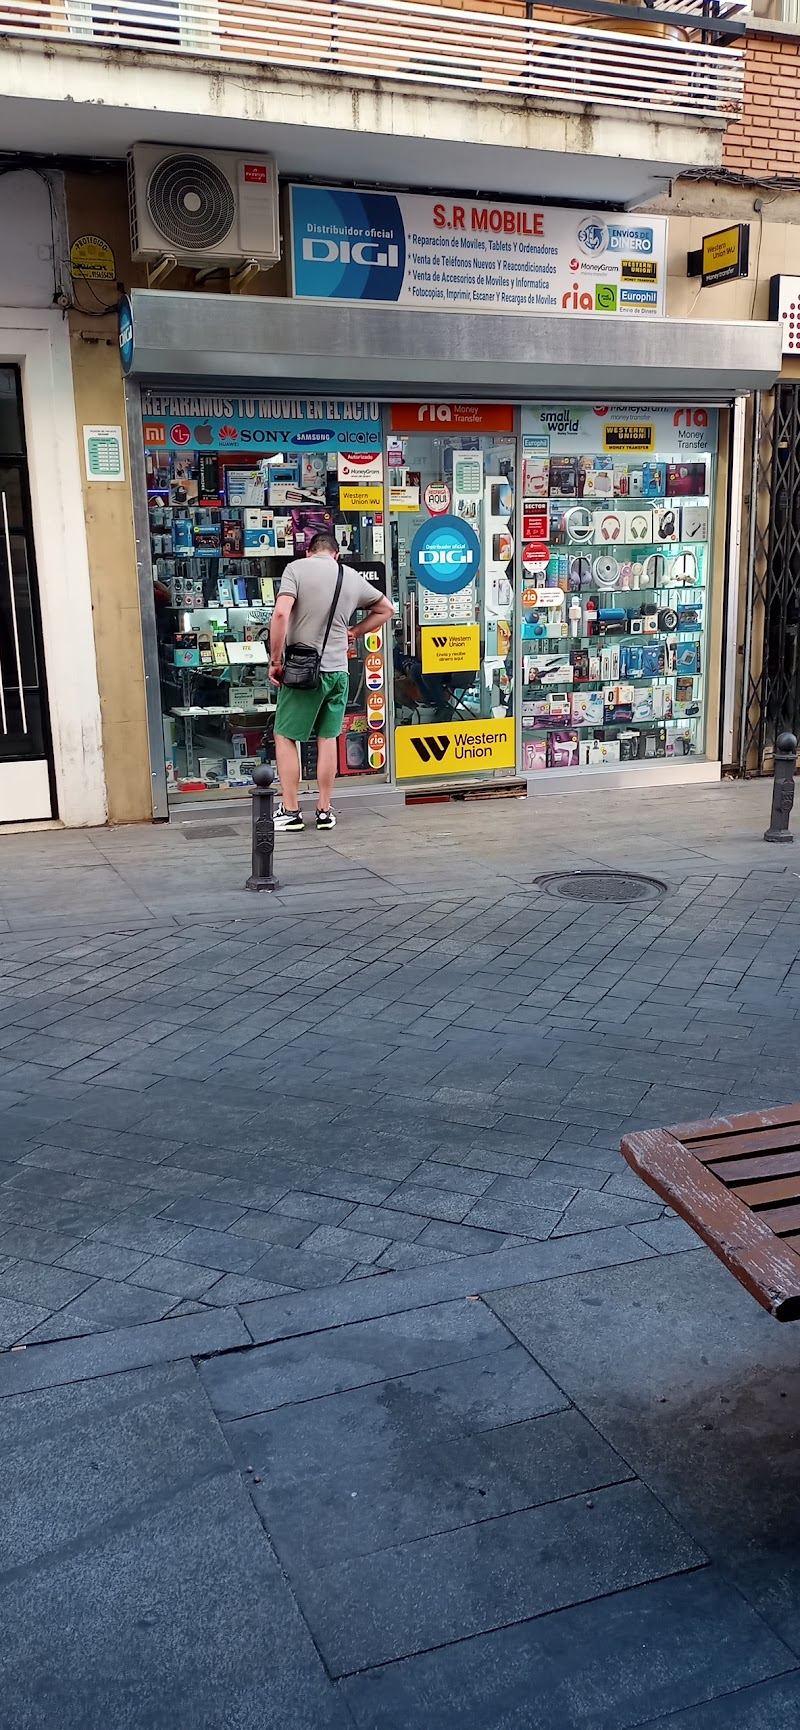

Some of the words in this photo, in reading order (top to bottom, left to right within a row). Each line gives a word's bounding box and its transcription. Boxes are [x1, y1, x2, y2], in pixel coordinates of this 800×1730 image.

[433, 204, 465, 229] S.R
[471, 207, 545, 236] MOBILE
[307, 223, 363, 236] Distribuidor
[365, 228, 393, 239] oficial
[451, 237, 459, 248] de
[488, 240, 512, 252] Tablets
[513, 242, 518, 252] Y
[519, 243, 558, 255] Ordenadores
[611, 237, 651, 251] DINERO
[707, 243, 726, 253] Western
[303, 238, 398, 267] DIGI
[412, 253, 431, 265] Venta
[432, 255, 440, 266] de
[473, 259, 496, 270] Nuevos
[497, 260, 502, 270] Y
[503, 261, 557, 274] Reacondicionados
[581, 262, 619, 272] MoneyGram
[412, 270, 431, 281] Venta
[432, 271, 440, 282] de
[442, 273, 475, 285] Accesorios
[477, 275, 484, 285] de
[486, 276, 510, 287] Moviles
[511, 280, 515, 289] y
[473, 291, 495, 301] Escaner
[496, 292, 501, 301] Y
[502, 292, 527, 305] Recargas
[528, 293, 535, 304] de
[536, 295, 557, 305] Moviles
[562, 283, 593, 310] ria
[622, 291, 656, 302] Europhil
[141, 397, 233, 418] REPARAMOS
[307, 401, 323, 419] EN
[327, 401, 341, 420] EL
[343, 401, 380, 421] ACTO
[418, 404, 452, 421] ria
[454, 405, 479, 414] Money
[454, 413, 482, 423] Transfer
[540, 410, 570, 422] small
[673, 407, 709, 427] ria
[548, 420, 579, 431] world
[240, 429, 291, 443] SONY
[297, 433, 330, 441] SAMSUNG
[337, 430, 380, 443] alcatel
[678, 430, 704, 440] Money
[524, 440, 547, 448] Europhil
[678, 440, 708, 449] Transfer
[419, 550, 473, 565] DIGI
[523, 592, 537, 602] ria
[367, 655, 381, 664] ria
[369, 694, 383, 704] ria
[370, 735, 384, 744] ria
[454, 732, 507, 746] Western
[454, 746, 492, 759] Union
